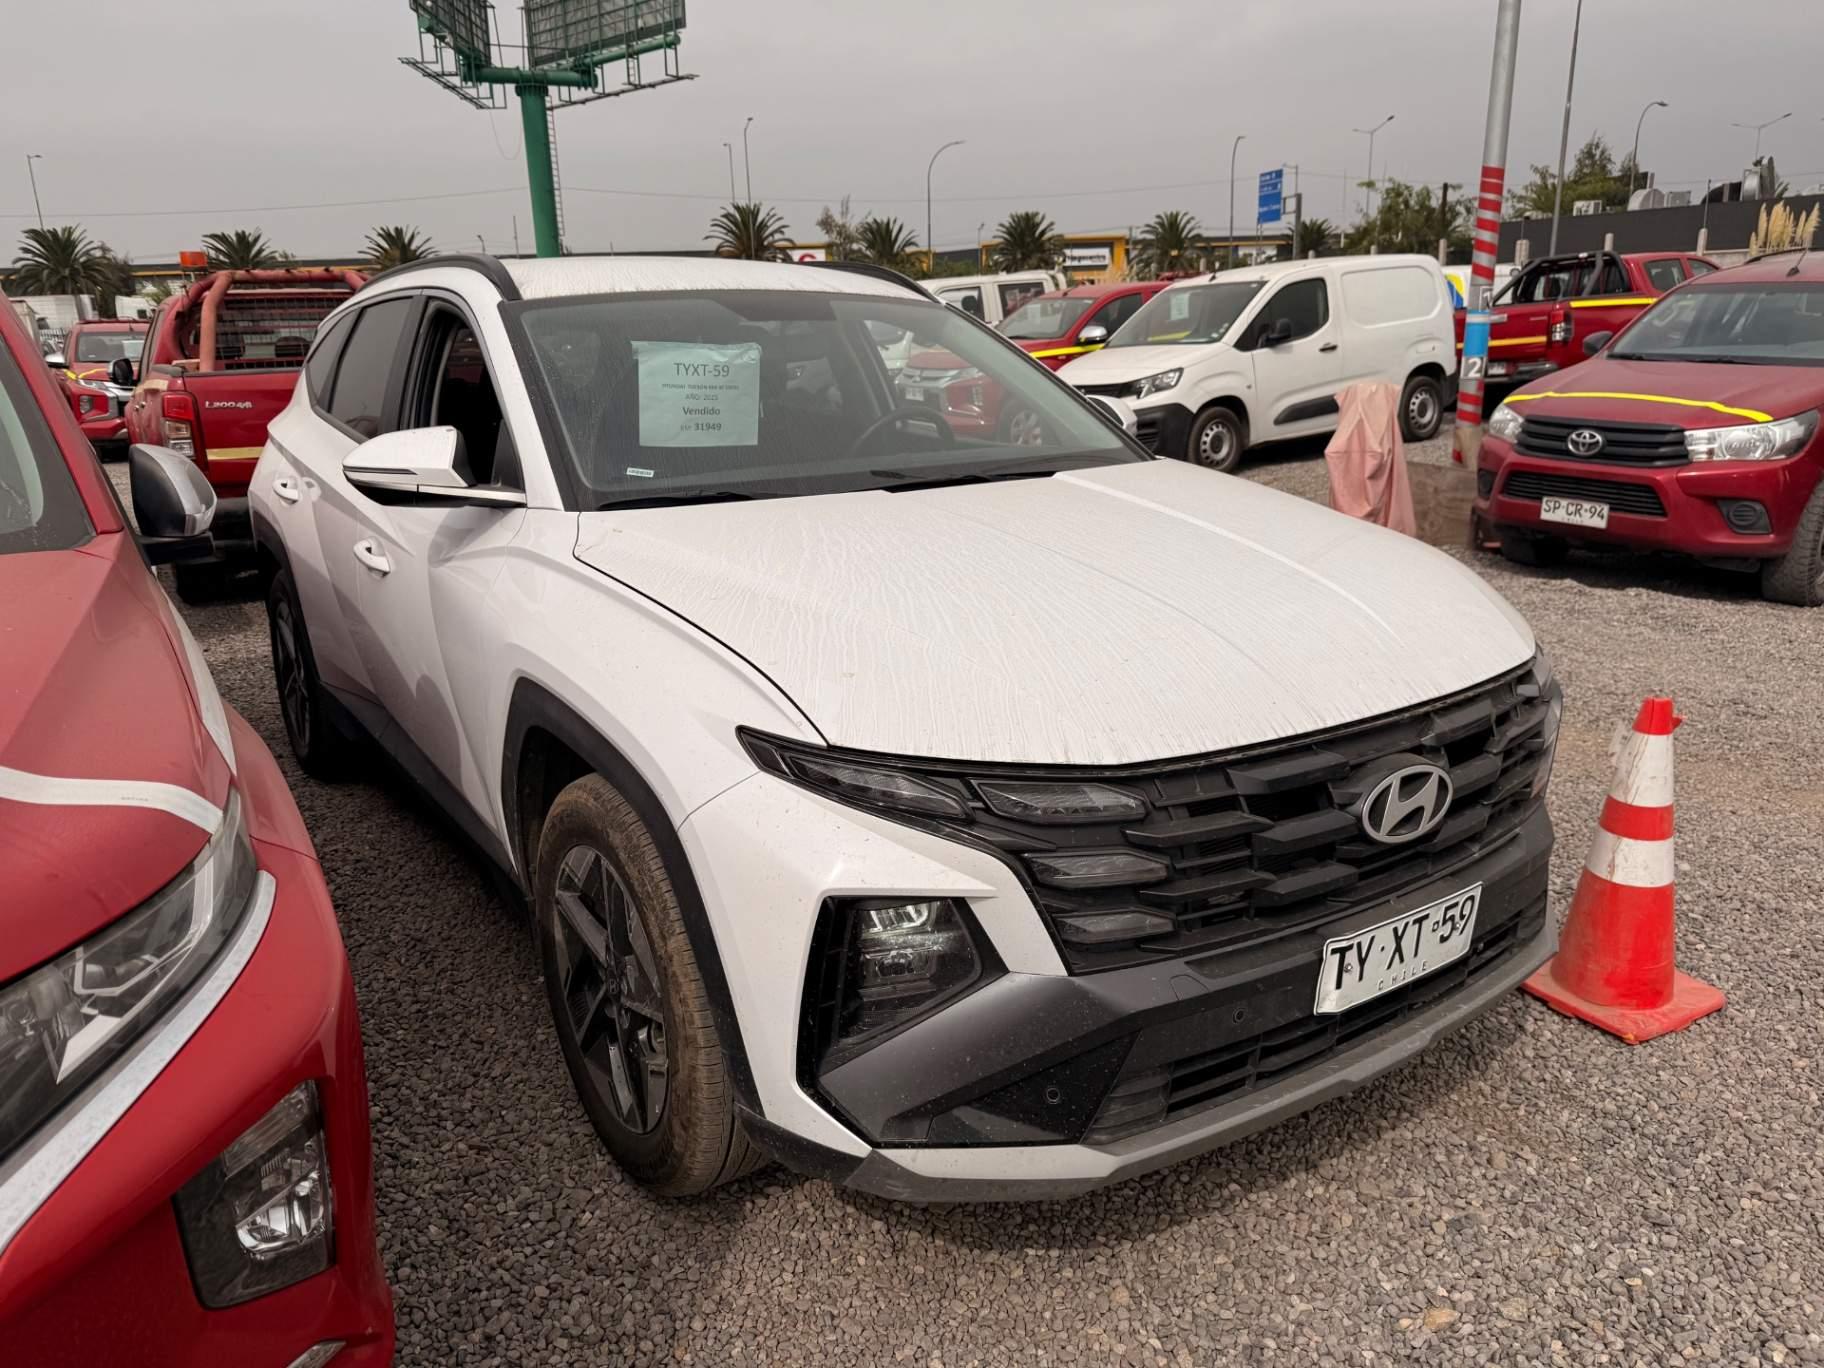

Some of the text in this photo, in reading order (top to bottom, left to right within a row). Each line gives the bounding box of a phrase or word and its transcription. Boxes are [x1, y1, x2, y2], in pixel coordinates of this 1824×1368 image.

[673, 362, 730, 378] TYXT-59
[1468, 357, 1482, 378] 2
[682, 406, 721, 416] Vendido
[694, 422, 722, 432] 31949
[1377, 960, 1429, 991] CHILE
